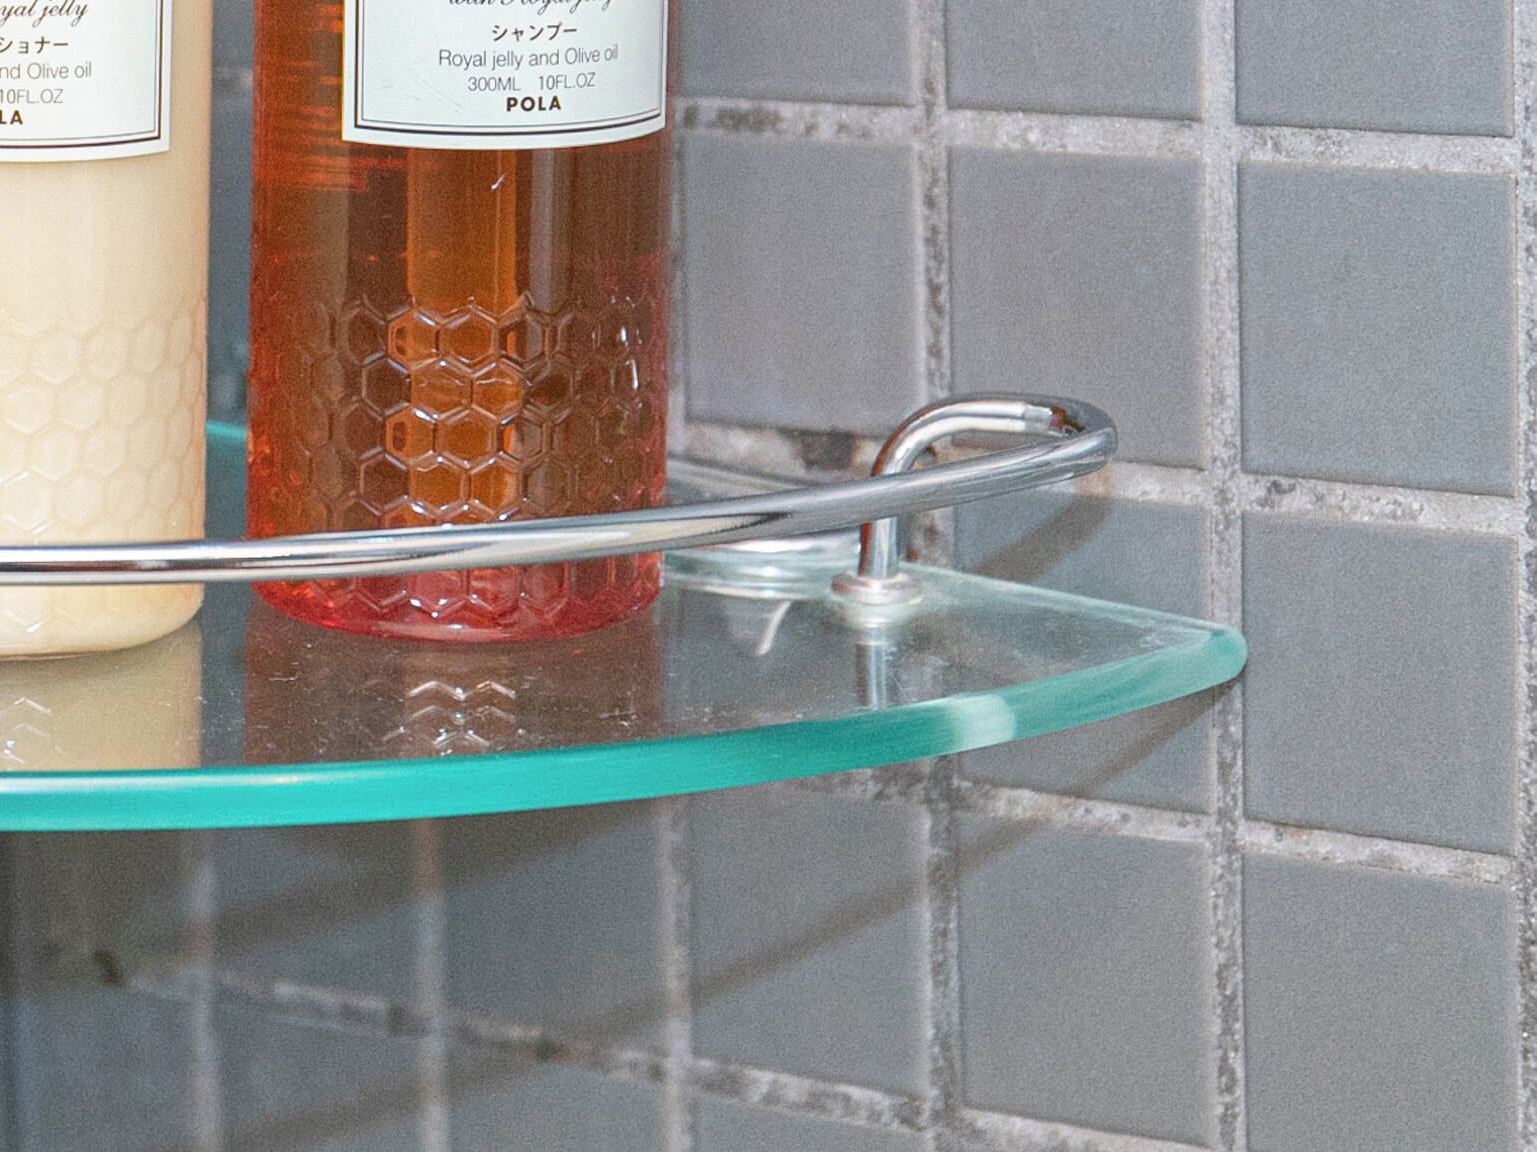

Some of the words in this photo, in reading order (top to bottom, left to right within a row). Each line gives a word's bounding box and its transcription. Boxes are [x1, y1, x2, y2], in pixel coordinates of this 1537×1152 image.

[492, 21, 577, 42] シャンプー
[439, 49, 487, 69] Royal
[492, 51, 523, 70] jelly
[529, 50, 560, 66] and
[565, 47, 600, 65] Olive
[605, 44, 618, 61] oil
[27, 62, 69, 79] Olive
[74, 61, 92, 78] oil
[468, 77, 521, 91] 300ML
[539, 73, 596, 90] 10FL.OZ
[0, 88, 63, 103] 10FL.OZ
[506, 96, 561, 111] POLA
